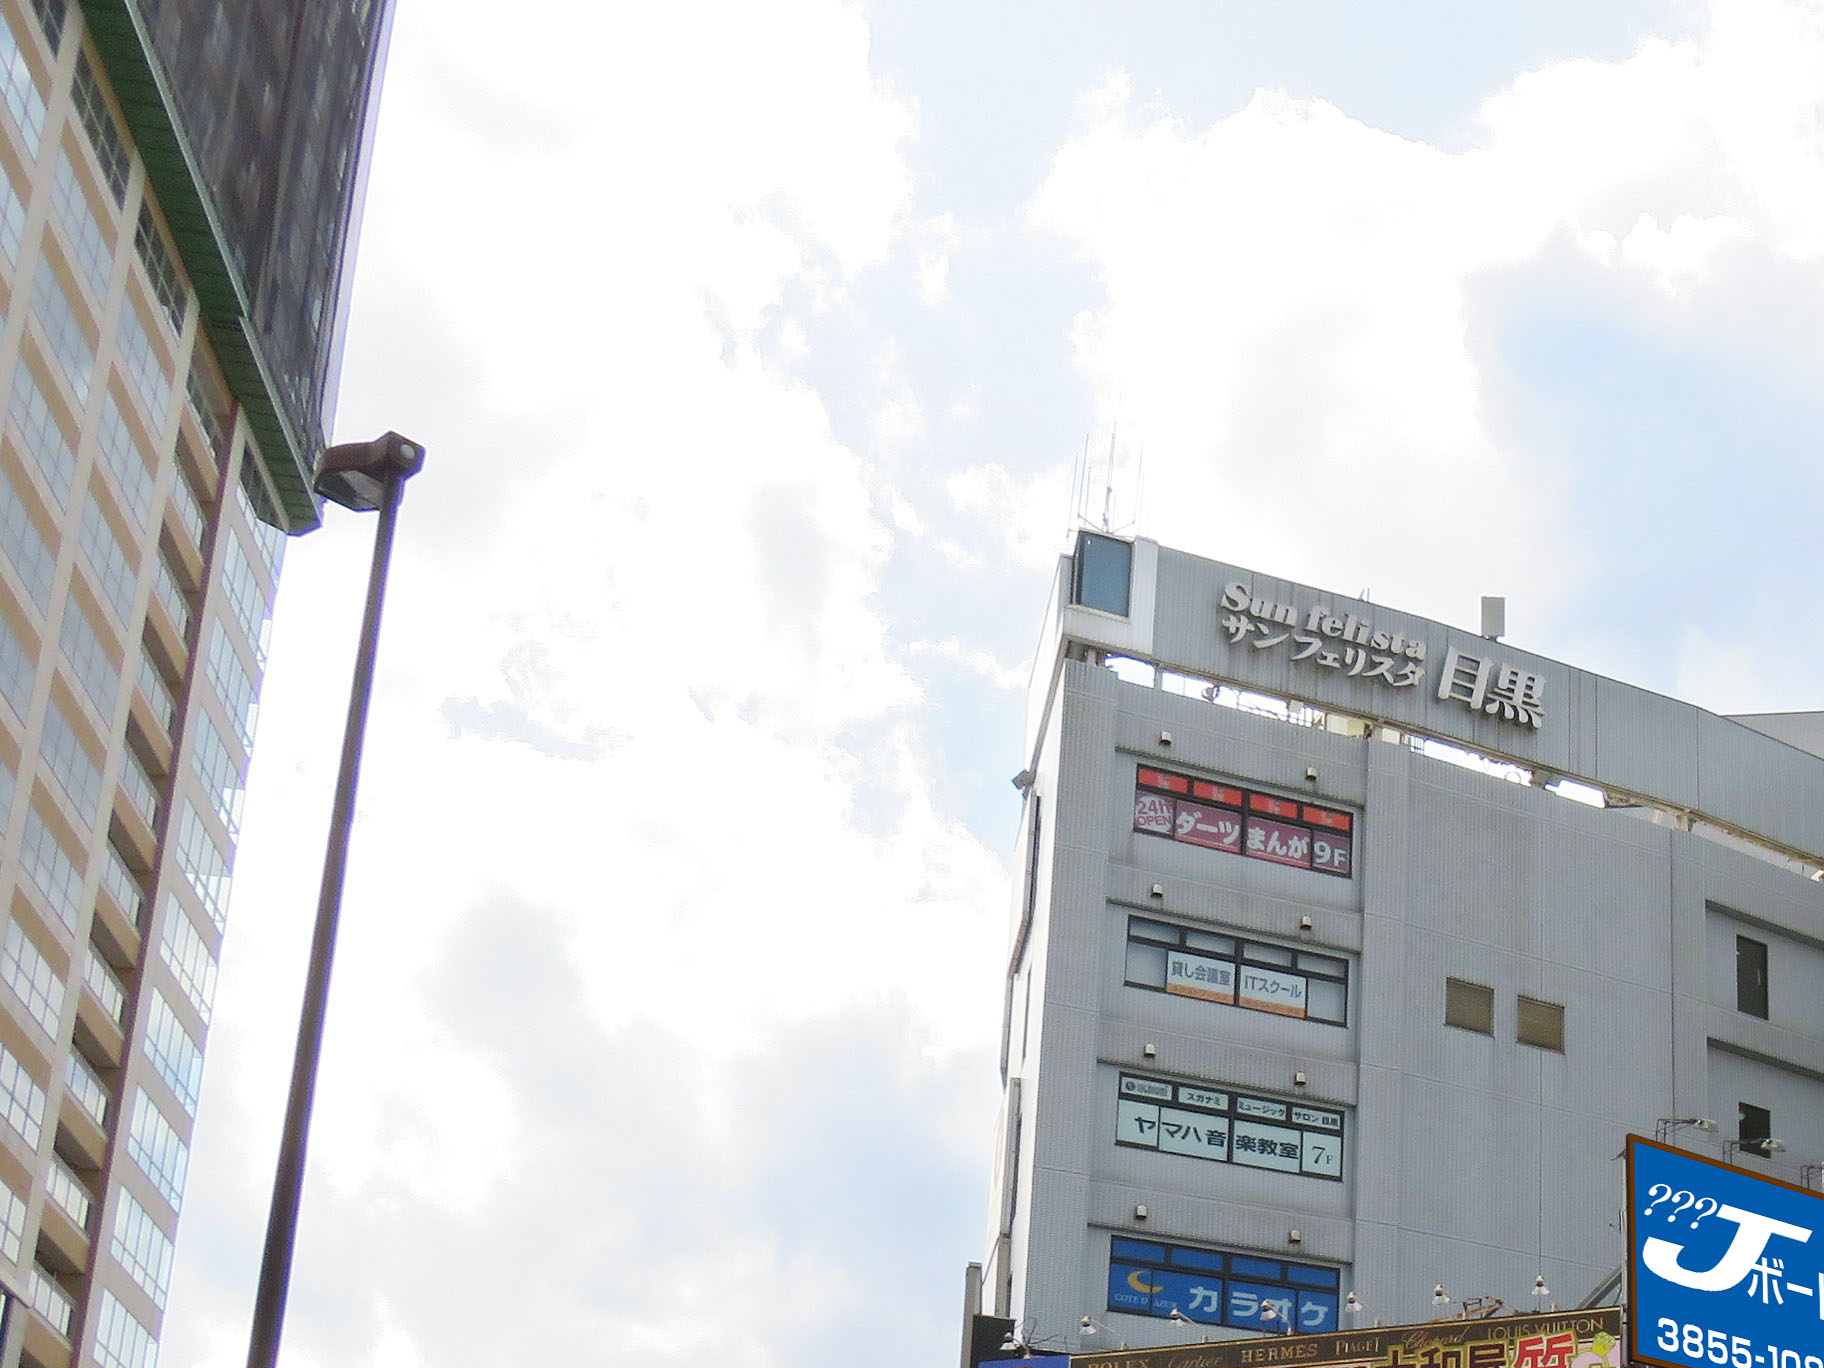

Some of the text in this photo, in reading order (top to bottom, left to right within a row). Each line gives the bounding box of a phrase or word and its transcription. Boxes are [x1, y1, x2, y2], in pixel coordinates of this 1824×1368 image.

[1220, 581, 1427, 661] Sun felista
[1222, 614, 1427, 688] サンフェリスタ
[1438, 645, 1547, 730] 目黒
[1137, 815, 1173, 828] OPEN
[1175, 811, 1349, 869] ダーツ まんが 9F
[1171, 961, 1303, 1000] 貸し会議室 ITスクール
[1238, 1100, 1285, 1117] ミュージック
[1311, 1145, 1333, 1165] 7F
[1189, 1286, 1329, 1327] カラオケ
[1241, 1344, 1318, 1362] HERMES
[1488, 1325, 1532, 1341] LOUIS
[1535, 1318, 1604, 1337] VUITTON
